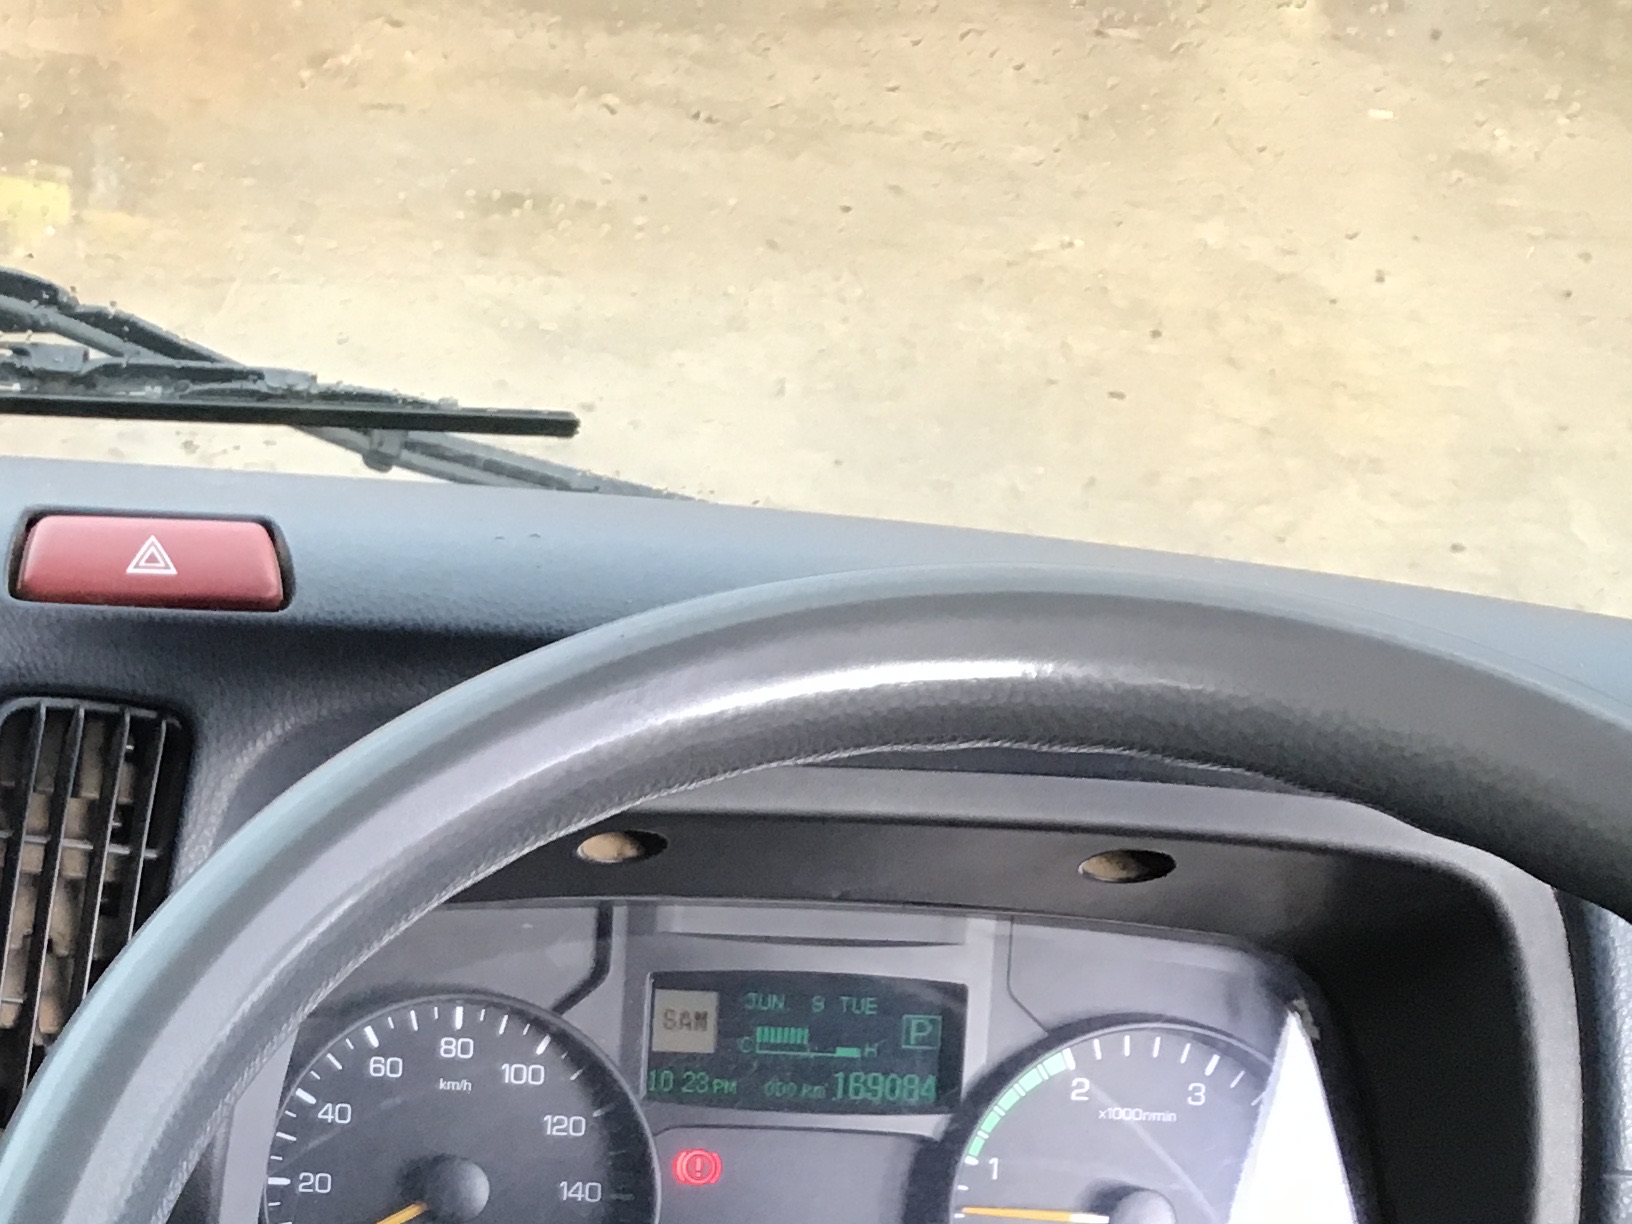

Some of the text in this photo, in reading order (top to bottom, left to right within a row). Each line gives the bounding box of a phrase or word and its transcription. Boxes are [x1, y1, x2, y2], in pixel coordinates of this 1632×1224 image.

[839, 995, 879, 1016] TUE
[662, 1008, 709, 1032] SAM
[909, 1018, 933, 1045] P
[440, 1037, 474, 1059] 80
[369, 1056, 403, 1078] 60
[500, 1063, 545, 1086] 100
[438, 1078, 473, 1095] km/h
[834, 1070, 937, 1105] 169084
[1070, 1076, 1091, 1102] 2
[1186, 1081, 1207, 1107] 3
[317, 1102, 352, 1125] 40
[543, 1114, 587, 1138] 120
[987, 1156, 999, 1181] 1
[298, 1171, 332, 1194] 20
[559, 1181, 603, 1203] 140
